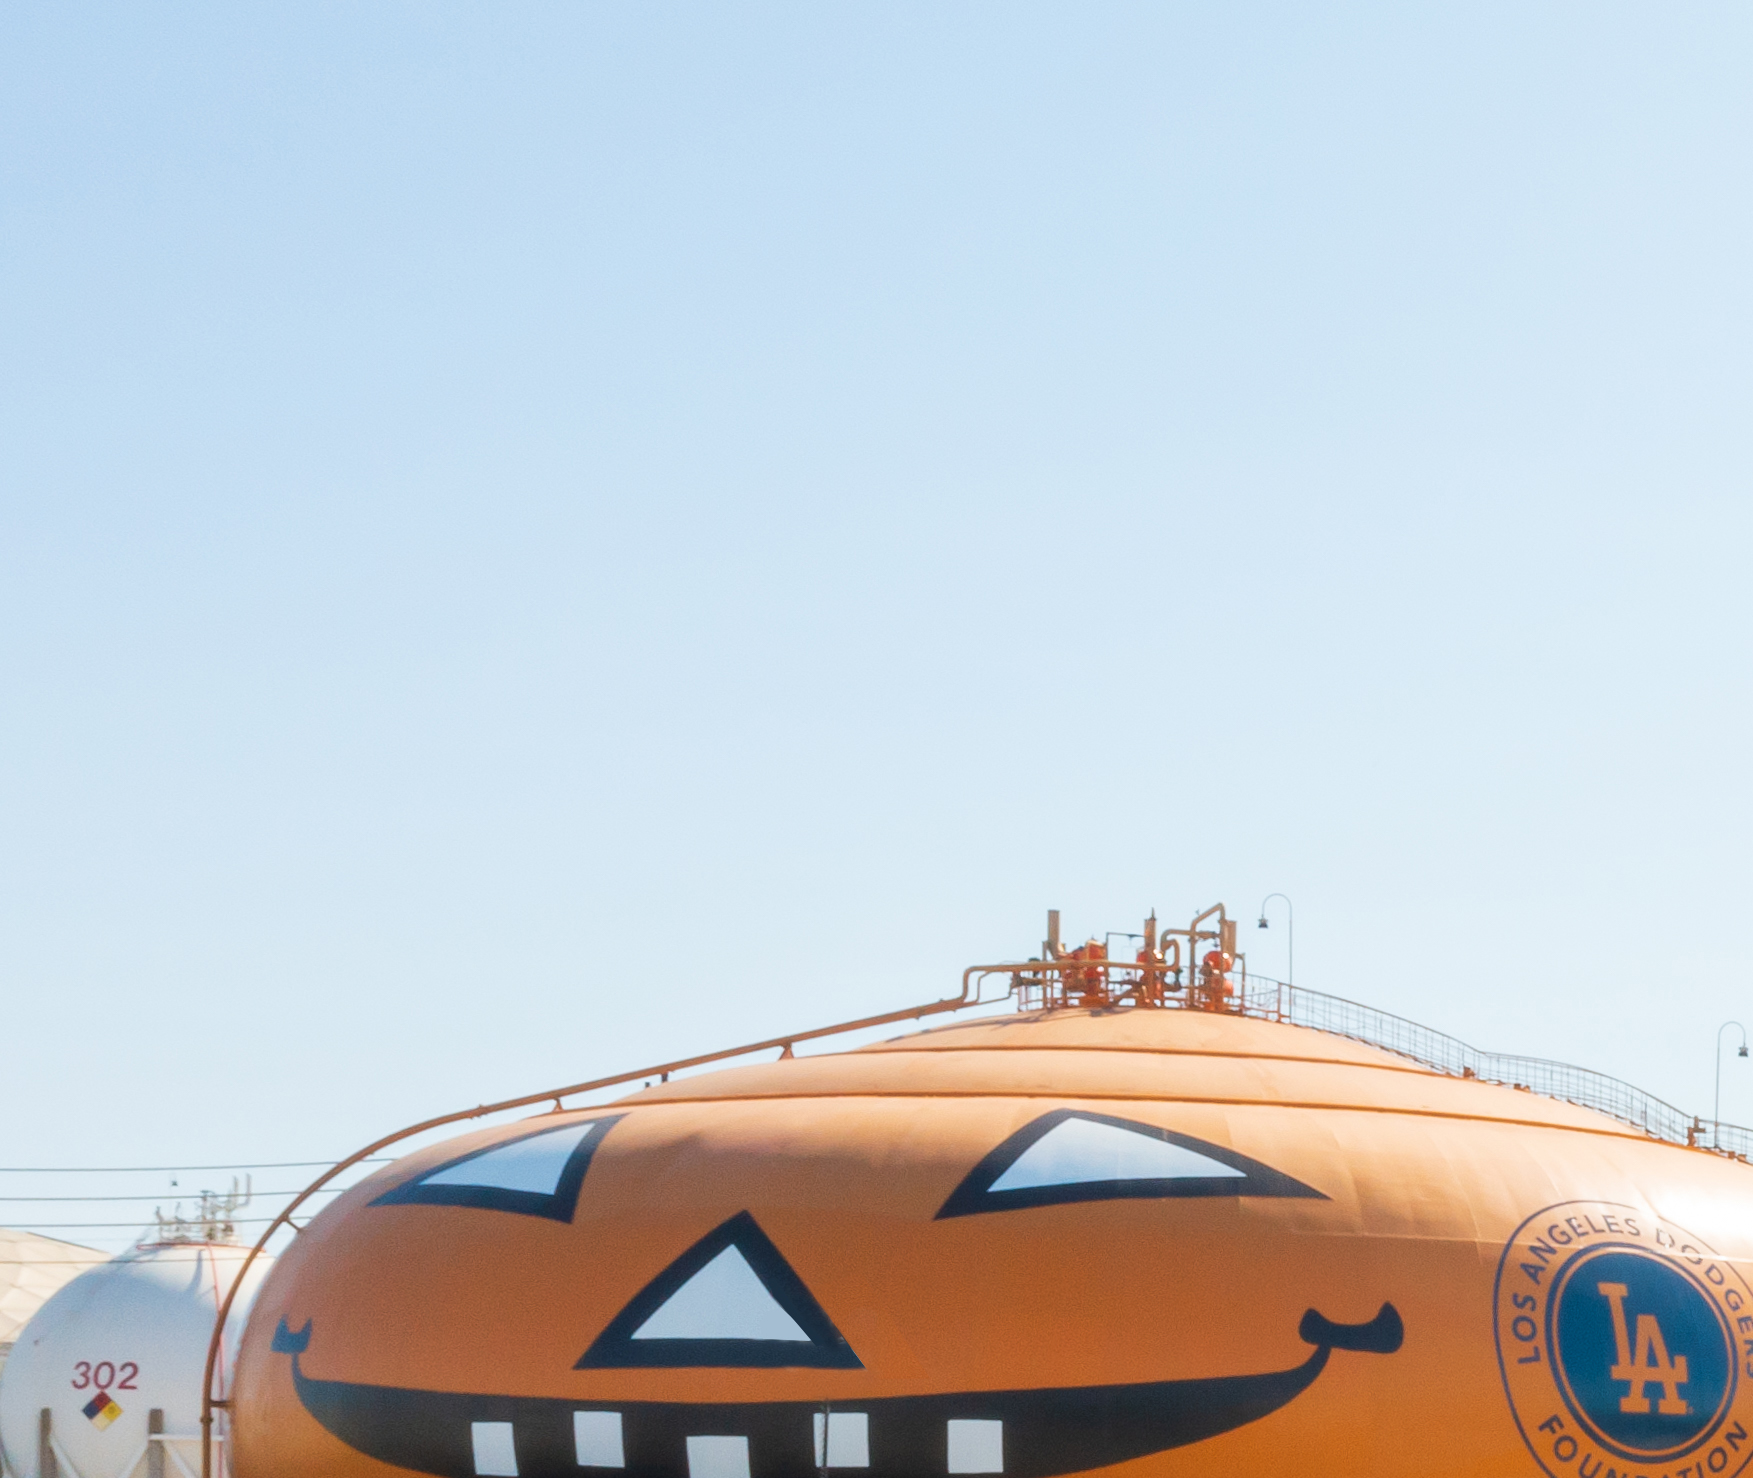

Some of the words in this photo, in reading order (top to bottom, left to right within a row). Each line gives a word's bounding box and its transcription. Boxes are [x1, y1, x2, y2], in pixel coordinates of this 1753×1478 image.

[1520, 1214, 1641, 1286] ANGELES
[1511, 1292, 1541, 1365] LOS
[1597, 1282, 1688, 1415] LA
[71, 1361, 139, 1390] 302
